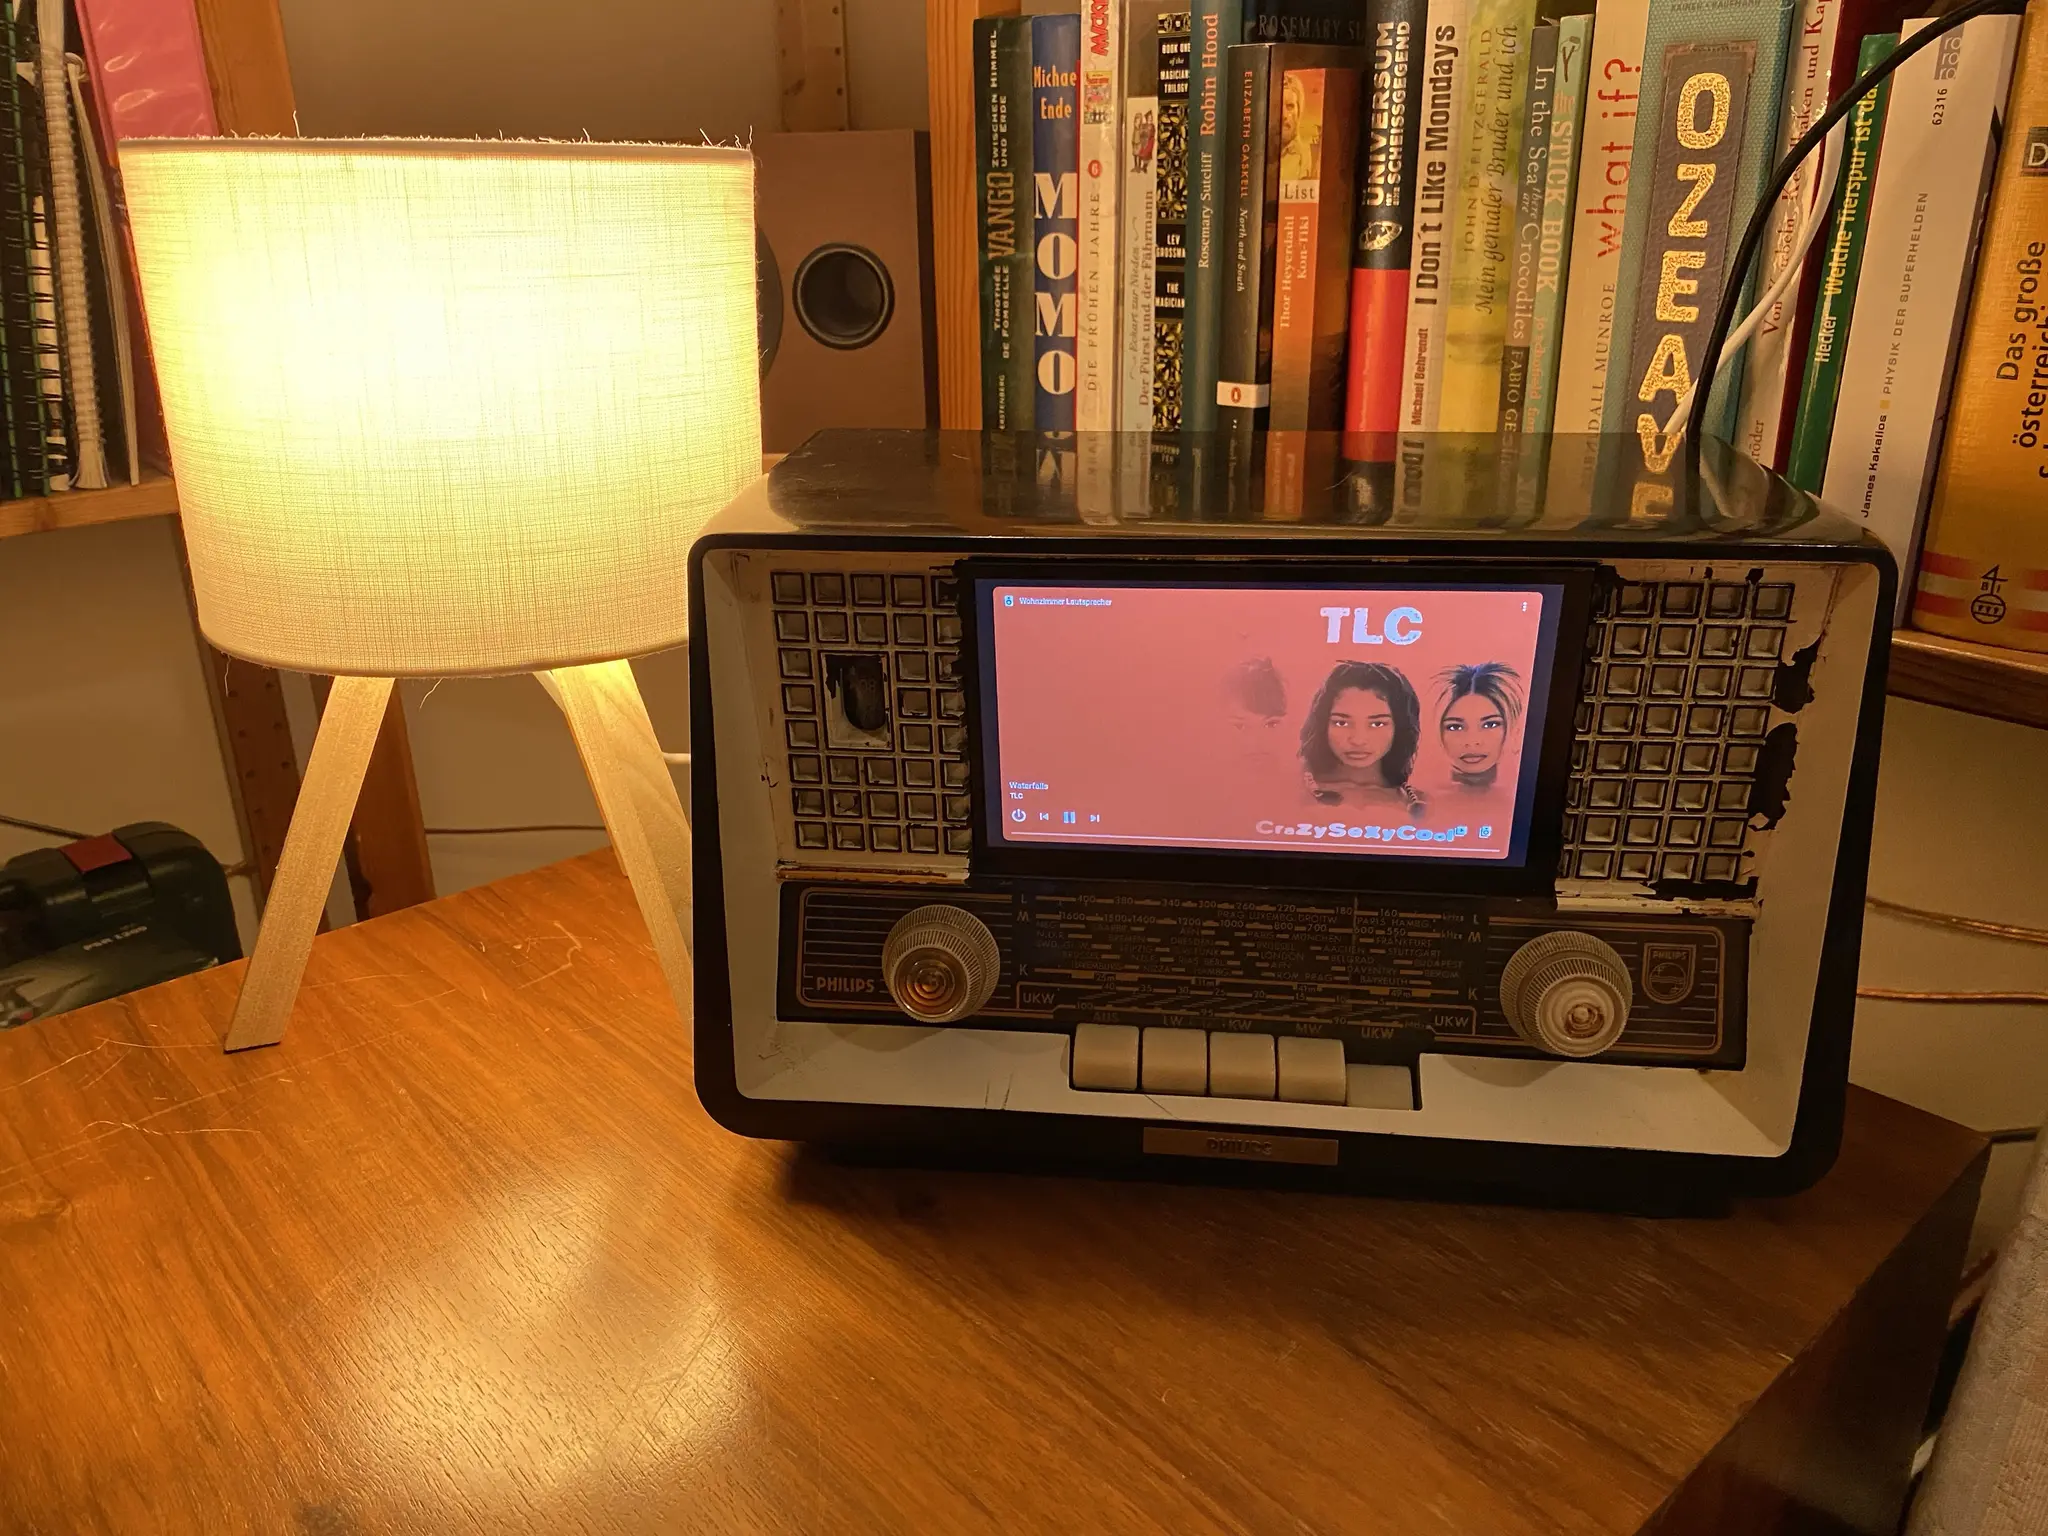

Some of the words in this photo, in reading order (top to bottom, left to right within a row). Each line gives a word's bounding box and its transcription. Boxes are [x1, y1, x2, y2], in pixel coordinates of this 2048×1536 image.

[1091, 0, 1109, 57] MICK
[1201, 13, 1218, 69] Hood
[1257, 14, 1340, 39] ROSEMARY
[1496, 25, 1517, 55] ich
[990, 30, 998, 87] HIMMEL
[1033, 65, 1077, 88] Michae
[1493, 59, 1513, 101] und
[1534, 65, 1555, 90] In
[1040, 97, 1072, 119] Ende
[1200, 76, 1217, 137] Robin
[1242, 71, 1253, 138] ELIZABETH
[1387, 21, 1411, 185] SCHEISSGEGEND
[1424, 24, 1458, 151] Mondays
[1470, 30, 1492, 165] FITZGERALD
[1597, 58, 1640, 119] if?
[1932, 88, 1947, 126] 62316
[991, 94, 999, 168] ZWISCHEN
[999, 96, 1007, 133] ERDE
[1366, 21, 1394, 206] UNIVERSUM
[1529, 100, 1550, 137] the
[1850, 118, 1873, 141] ist
[1485, 107, 1510, 177] Bruder
[1525, 145, 1548, 186] Sea
[1543, 120, 1573, 208] STICK
[1200, 152, 1213, 201] Sutcliff
[1240, 144, 1250, 199] GASKELL
[1284, 184, 1314, 199] List
[1420, 161, 1446, 214] Like
[1761, 300, 1783, 336] Von
[1802, 45, 1819, 79] und
[1836, 150, 1867, 224] Tierspur
[986, 172, 1016, 261] VANGO
[1238, 208, 1249, 238] North
[1463, 198, 1478, 252] JOHN
[1481, 183, 1505, 262] genialer
[1521, 192, 1531, 213] are
[1528, 187, 1542, 219] there
[1585, 141, 1632, 258] what
[1089, 194, 1100, 257] JAHRE
[1140, 190, 1154, 270] Fährmann
[1198, 206, 1214, 268] Rosemary
[1237, 241, 1247, 260] and
[1296, 215, 1309, 280] Kon-Tiki
[1899, 192, 1928, 303] SUPERHELDEN
[1235, 263, 1246, 292] South
[1281, 215, 1295, 291] Heyerdahl
[1534, 220, 1562, 294] BOOK
[1637, 73, 1729, 432] OZEA
[1823, 231, 1852, 296] Welche
[1001, 265, 1010, 338] FOMBELLE
[1033, 172, 1077, 395] MOMO
[1140, 272, 1152, 299] der
[1474, 267, 1496, 314] Mein
[1512, 222, 1540, 339] Crocodiles
[1086, 270, 1098, 348] FRÜHEN
[1140, 303, 1151, 333] und
[1279, 294, 1291, 329] Thor
[1594, 283, 1615, 372] MUNROE
[1893, 308, 1907, 337] DER
[1996, 333, 2026, 380] Das
[2014, 241, 2046, 323] große
[1002, 342, 1010, 359] DE
[1139, 336, 1151, 375] Fürst
[1414, 328, 1428, 380] Behrendt
[1815, 315, 1837, 363] Hecker
[1087, 360, 1098, 391] DIE
[1138, 379, 1150, 406] Der
[1507, 351, 1524, 402] FABIO
[1882, 342, 1900, 394] PHYSIK
[998, 375, 1006, 430] ERSTENBERG
[1411, 382, 1424, 425] Michael
[1504, 408, 1518, 433] GE
[1587, 381, 1604, 432] DALL
[1749, 420, 1764, 463] röder
[1868, 414, 1887, 471] Kakalios
[1861, 474, 1876, 518] James
[1019, 597, 1065, 605] Wohnzimmer
[1066, 598, 1112, 606] Lautsprecher
[1320, 606, 1423, 645] TLC
[1009, 781, 1049, 790] Waterfalls
[1017, 912, 1029, 921] M
[1220, 919, 1244, 928] 1000
[1274, 922, 1294, 930] 800
[1307, 924, 1327, 932] 700
[1468, 932, 1481, 943] M
[1021, 894, 1027, 904] L
[1162, 899, 1180, 907] 340
[1336, 907, 1352, 915] 180
[1380, 909, 1398, 917] 160
[1473, 914, 1480, 925] L
[816, 976, 874, 993] PHILIPS
[1019, 964, 1028, 976] K
[1468, 988, 1478, 1000] K
[1023, 992, 1055, 1004] UKW
[1434, 1015, 1468, 1027] UKW
[1361, 1027, 1394, 1038] UKW
